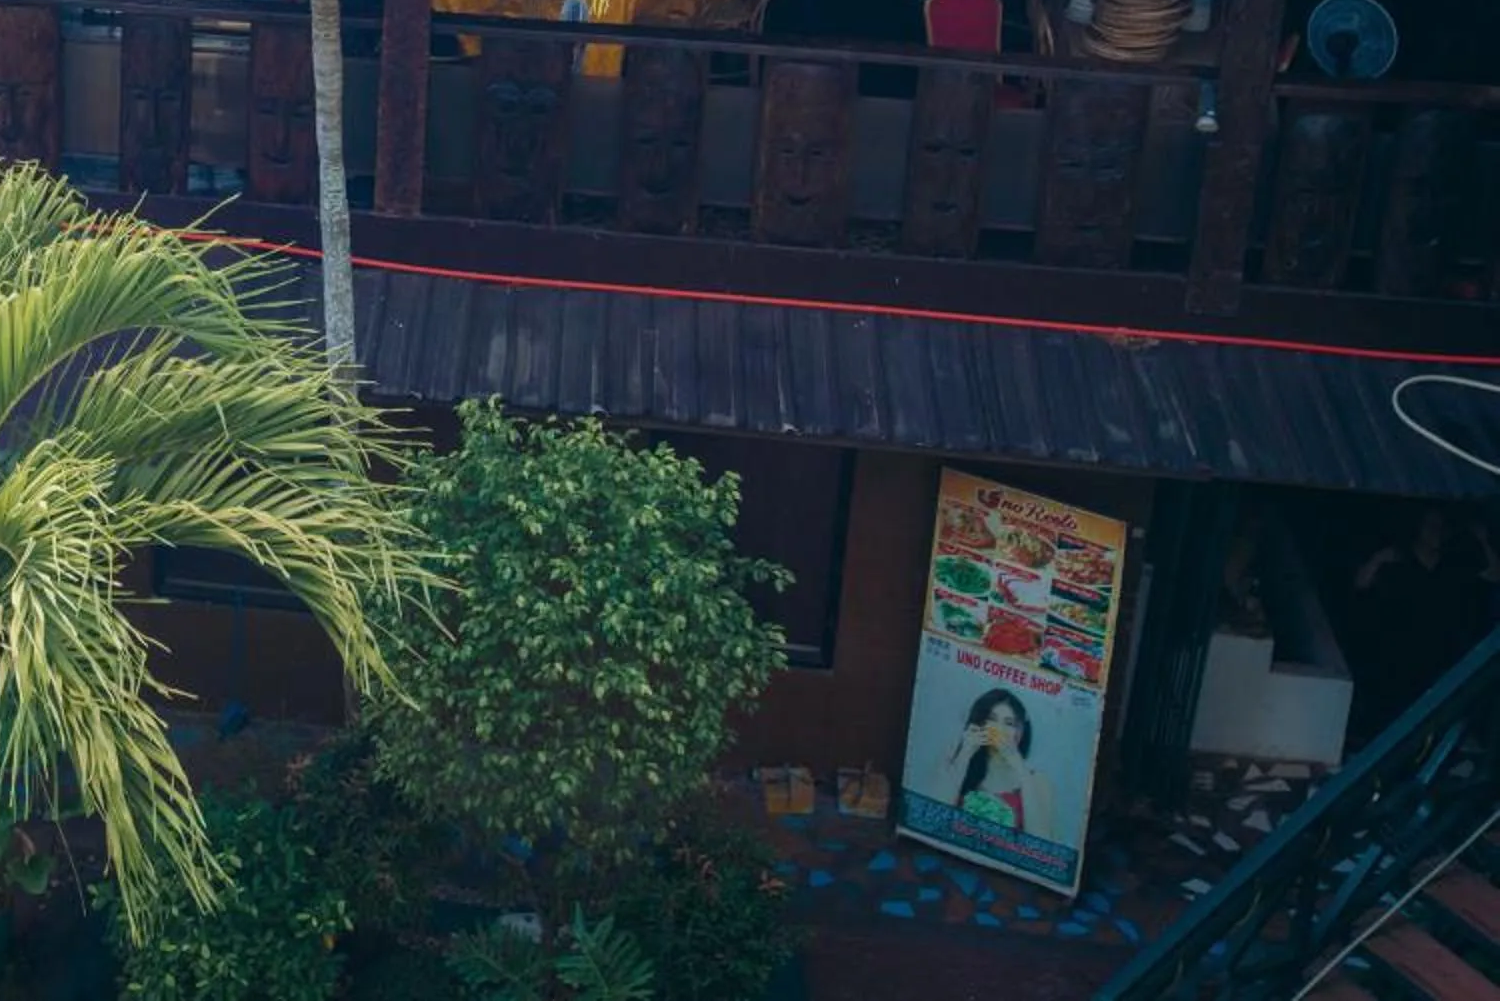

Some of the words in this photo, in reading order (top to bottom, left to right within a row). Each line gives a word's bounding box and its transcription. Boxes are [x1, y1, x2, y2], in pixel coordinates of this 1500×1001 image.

[956, 649, 981, 670] UNO
[983, 659, 1027, 686] COFFEE
[1029, 676, 1062, 696] SHOP
